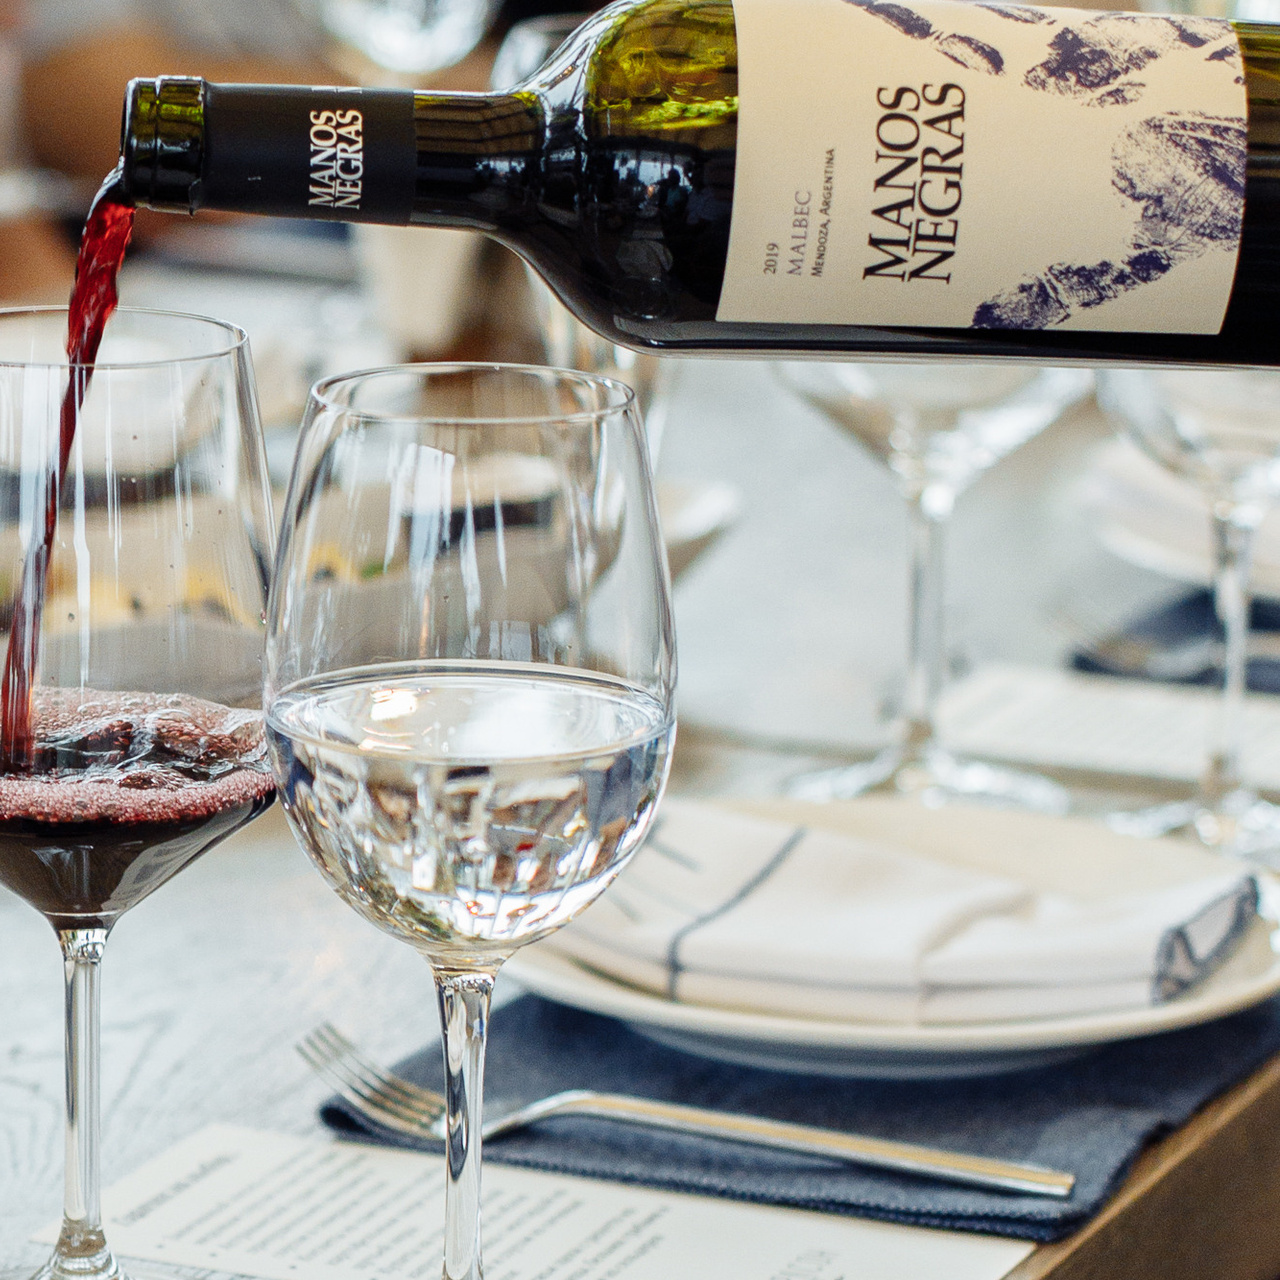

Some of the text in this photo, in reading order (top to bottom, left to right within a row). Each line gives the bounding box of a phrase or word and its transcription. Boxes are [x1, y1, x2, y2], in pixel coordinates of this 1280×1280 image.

[307, 110, 338, 208] MANOS
[334, 109, 364, 210] NEGRAS
[862, 86, 921, 282] MANOS
[906, 82, 966, 284] NEGRAS
[763, 242, 779, 276] 2019
[785, 190, 812, 276] MALBEC
